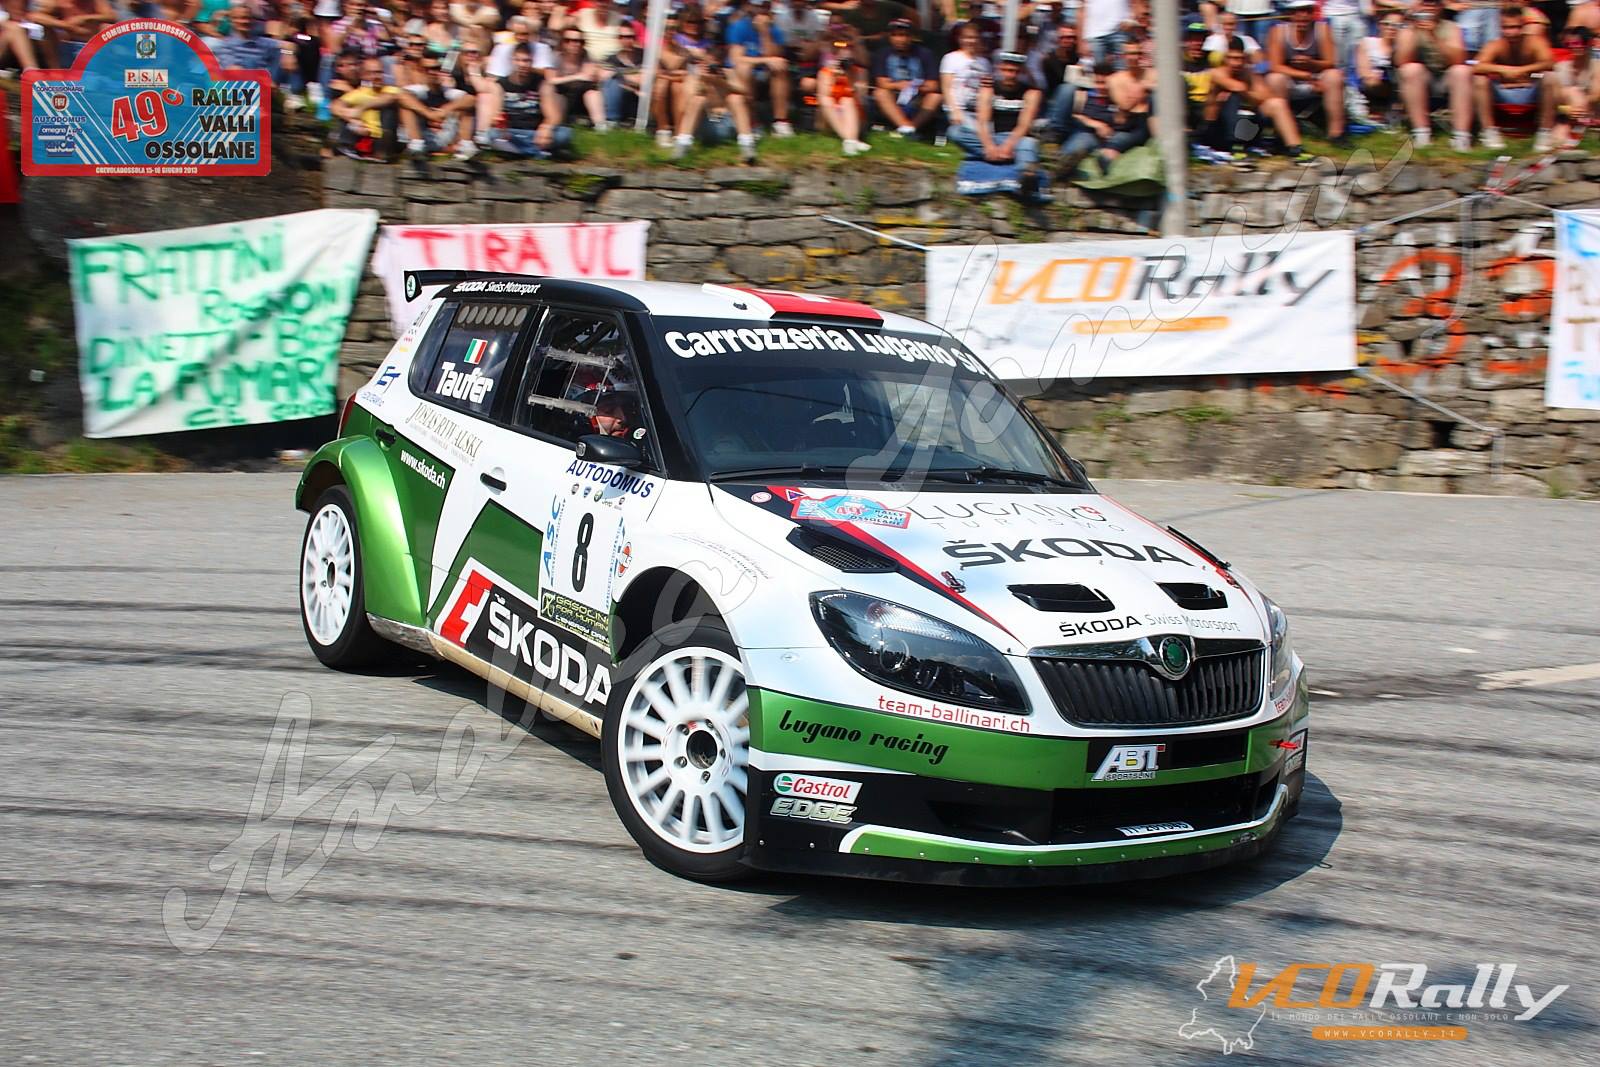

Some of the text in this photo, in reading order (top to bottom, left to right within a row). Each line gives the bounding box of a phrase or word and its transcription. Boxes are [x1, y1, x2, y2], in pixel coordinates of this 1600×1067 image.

[401, 229, 551, 275] TIRA
[665, 325, 856, 359] Carrozzeria
[850, 328, 957, 368] Lugano
[435, 361, 494, 404] Taufer
[400, 449, 446, 490] www.skoda.ch
[566, 459, 654, 499] AUTODOMUS
[874, 508, 904, 517] RALLY
[906, 502, 1107, 522] LUGANO
[571, 512, 594, 593] 8
[942, 538, 1196, 570] ŠKODA
[1058, 614, 1241, 638] ŠKODA Swiss Motorsport
[487, 593, 612, 706] ŠKODA
[878, 695, 1031, 733] team-ballinari.ch
[778, 710, 950, 766] Lugano racing
[1091, 744, 1167, 782] ABT
[1105, 770, 1157, 781] SPORTSLINE
[793, 778, 851, 799] Castrol
[769, 797, 858, 825] EDGE
